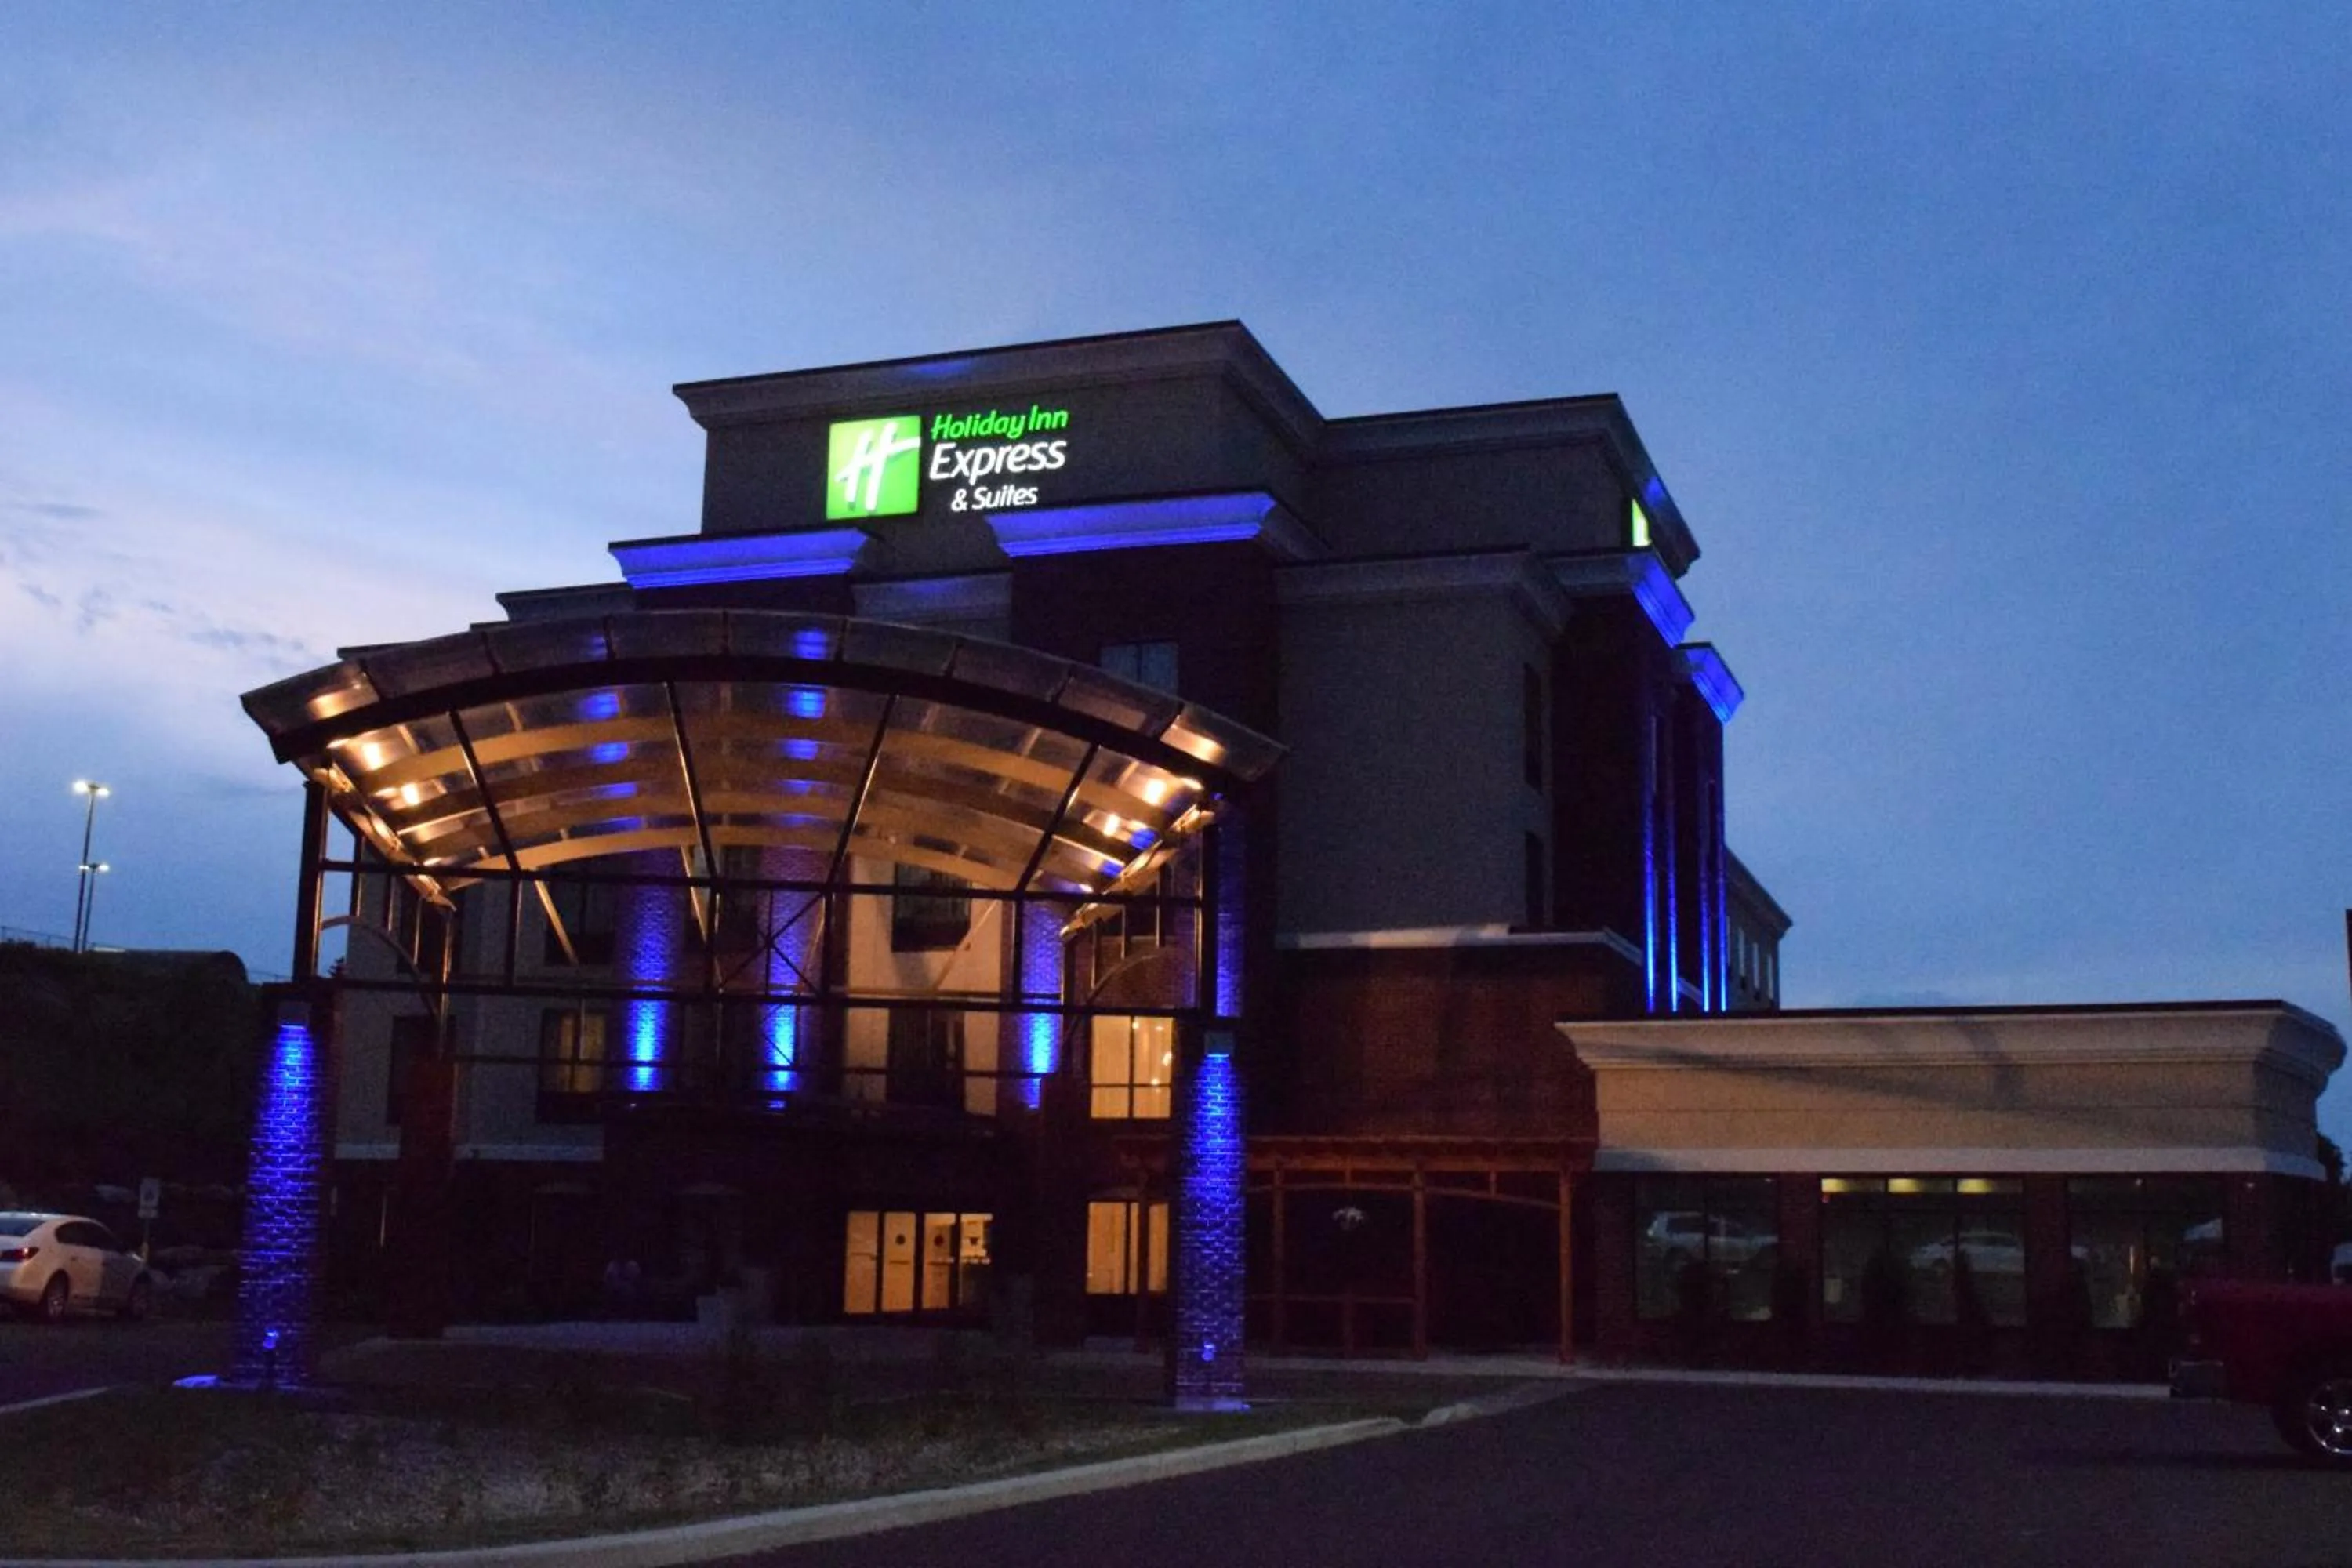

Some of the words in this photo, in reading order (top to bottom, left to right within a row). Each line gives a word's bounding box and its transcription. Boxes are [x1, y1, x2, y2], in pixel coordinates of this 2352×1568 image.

[931, 409, 1025, 440] Holiday
[1028, 404, 1069, 430] Inn
[929, 440, 1067, 486] Express
[950, 488, 967, 512] &
[971, 484, 1039, 510] Suites
